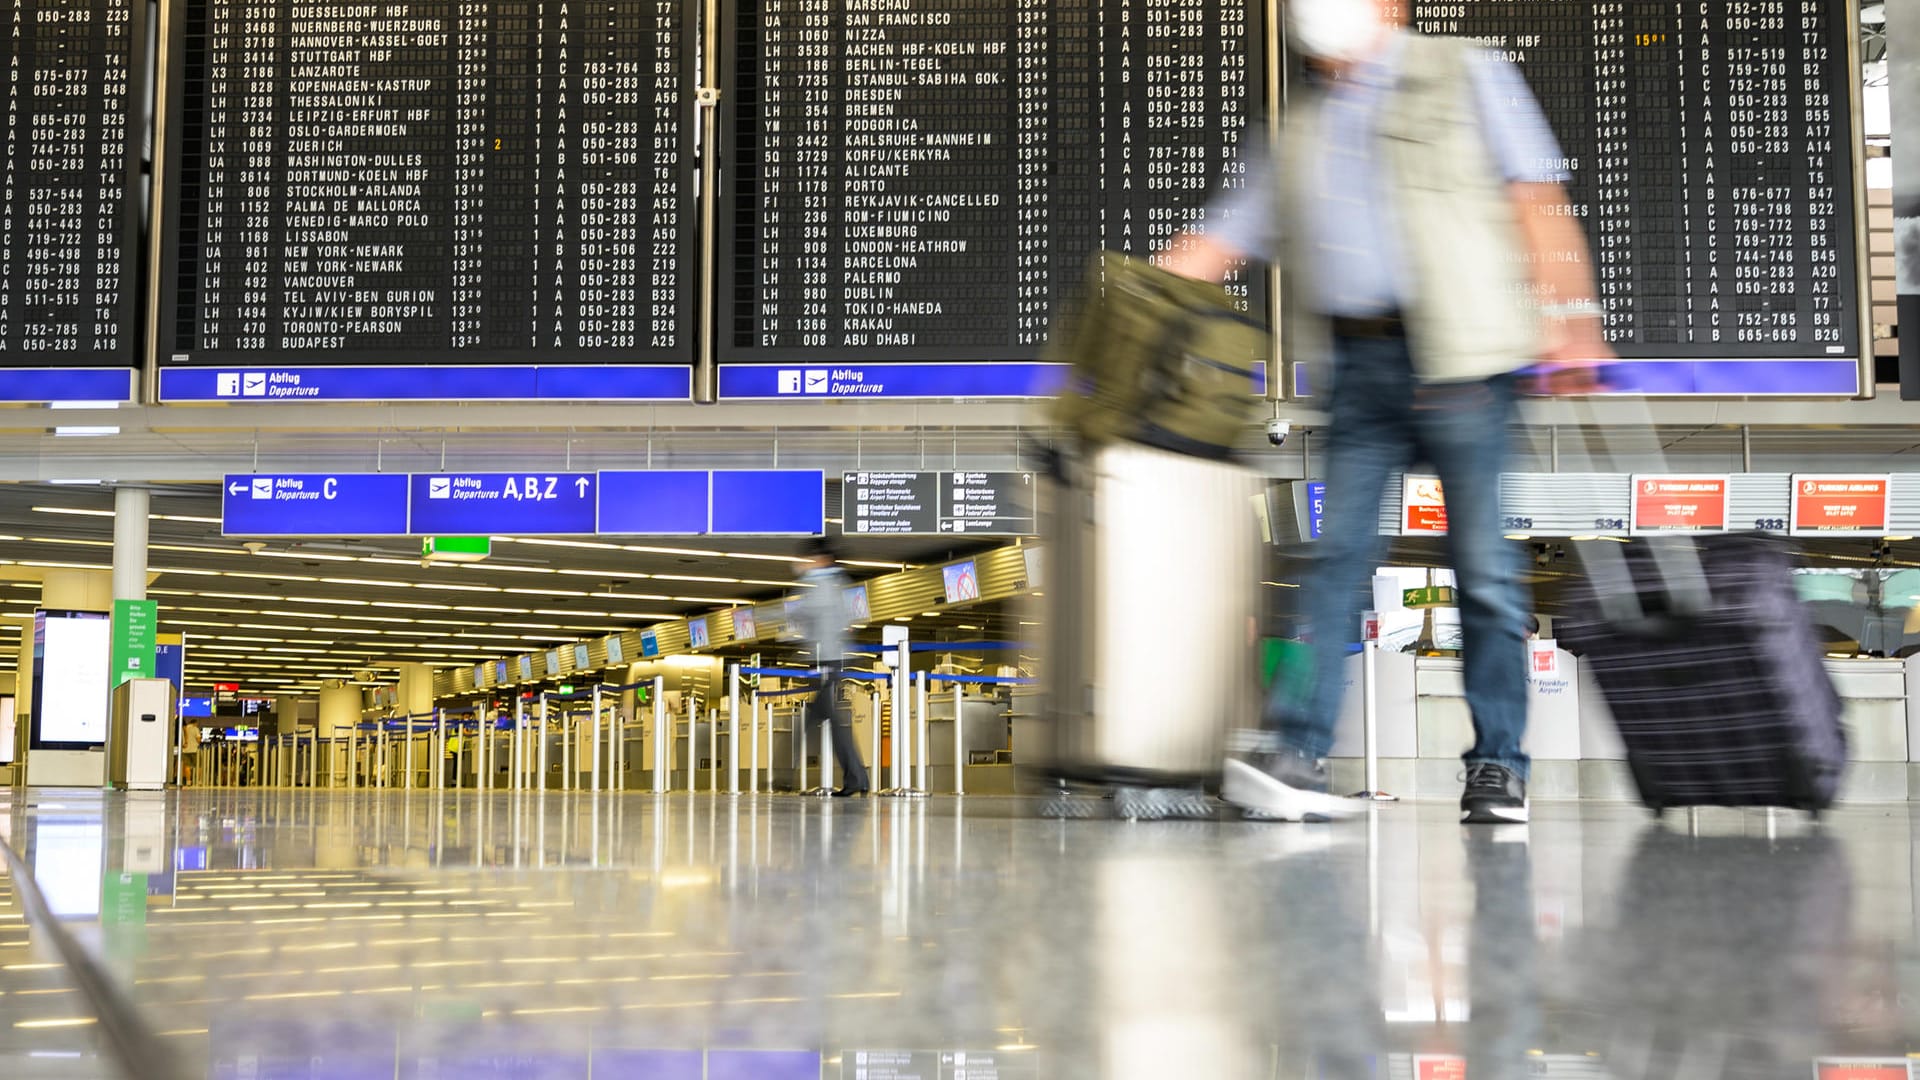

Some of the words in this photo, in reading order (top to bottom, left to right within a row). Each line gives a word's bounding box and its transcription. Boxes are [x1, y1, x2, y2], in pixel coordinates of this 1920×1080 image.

[292, 6, 377, 18] DUESSELDORF
[386, 5, 408, 17] HBF
[846, 0, 909, 11] WARSCHAU
[1416, 5, 1465, 18] RHODOS
[1726, 2, 1783, 14] 752-785
[1801, 2, 1817, 13] B4
[846, 14, 869, 26] SAN
[879, 12, 950, 25] FRANCISCO
[292, 19, 440, 33] NUERNBERG-WUERZBURG
[1417, 21, 1457, 32] TURIN
[291, 34, 448, 48] HANNOVER-KASSEL-GOET
[846, 29, 885, 41] NIZZA
[1517, 35, 1540, 47] HBF
[845, 44, 893, 56] AACHEN
[902, 42, 975, 55] HBF-KOELN
[983, 42, 1006, 54] HBF
[1728, 48, 1785, 60] 517-519
[1803, 48, 1827, 60] B12
[244, 52, 274, 63] 3414
[291, 50, 360, 63] STUTTGART
[370, 50, 392, 61] HBF
[846, 58, 941, 71] BERLIN-TEGEL
[34, 69, 87, 81] 675-677
[104, 69, 126, 80] A24
[291, 65, 359, 77] LANZAROTE
[290, 79, 431, 92] KOPENHAGEN-KASTRUP
[765, 75, 780, 87] TK
[798, 74, 828, 87] 7735
[848, 73, 966, 86] ISTANBUL-SABIHA
[975, 72, 1005, 84] GOK.
[290, 95, 381, 107] THESSALONIKI
[846, 89, 901, 101] DRESDEN
[242, 111, 272, 123] 3734
[290, 110, 399, 122] LEIPZIG-ERFURT
[408, 109, 430, 121] HBF
[846, 104, 893, 116] BREMEN
[289, 124, 406, 137] OSLO-GARDERMOEN
[846, 119, 918, 131] PODGORICA
[845, 133, 991, 146] KARLSRUHE-MANNHEIM
[32, 144, 83, 155] 744-751
[101, 143, 123, 155] B26
[288, 140, 342, 152] ZUERICH
[288, 154, 421, 167] WASHINGTON-DULLES
[583, 152, 637, 164] 501-506
[654, 152, 677, 164] Z20
[846, 149, 950, 161] KORFU/KERKYRA
[287, 170, 397, 182] DORTMUND-KOELN
[406, 169, 428, 181] HBF
[845, 164, 909, 177] ALICANTE
[287, 185, 421, 197] STOCKHOLM-ARLANDA
[764, 181, 779, 193] LH
[798, 180, 827, 192] 1178
[845, 180, 885, 192] PORTO
[30, 189, 82, 200] 537-544
[100, 188, 122, 199] B45
[241, 201, 269, 213] 1152
[286, 201, 325, 212] PALMA
[334, 200, 348, 212] DE
[358, 200, 420, 211] MALLORCA
[764, 196, 777, 208] FI
[805, 196, 826, 208] 521
[845, 194, 999, 207] REYKJAVIK-CANCELLED
[286, 215, 388, 227] VENEDIG-MARCO
[397, 215, 428, 226] POLO
[845, 210, 950, 222] ROM-FIUMICINO
[28, 218, 81, 230] 441-443
[99, 218, 112, 229] C1
[1735, 219, 1792, 231] 769-772
[1810, 218, 1826, 230] B3
[286, 231, 348, 242] LISSABON
[845, 225, 917, 238] LUXEMBURG
[28, 233, 81, 245] 719-722
[98, 233, 112, 244] B9
[1735, 234, 1792, 247] 769-772
[1811, 234, 1826, 246] B5
[285, 246, 308, 257] NEW
[317, 245, 403, 257] YORK-NEWARK
[845, 240, 967, 253] LONDON-HEATHROW
[245, 261, 267, 273] 402
[284, 261, 308, 272] NEW
[317, 260, 402, 272] YORK-NEWARK
[763, 257, 778, 269] LH
[797, 257, 826, 269] 1134
[844, 256, 917, 268] BARCELONA
[27, 263, 80, 275] 795-798
[97, 263, 119, 274] B28
[1736, 266, 1794, 278] 050-283
[1812, 265, 1836, 277] A20
[284, 276, 354, 288] VANCOUVER
[844, 271, 900, 284] PALERMO
[26, 294, 78, 305] 511-515
[96, 293, 118, 304] B47
[205, 292, 219, 303] LH
[244, 292, 266, 303] 694
[284, 291, 305, 303] TEL
[315, 291, 378, 302] AVIV-BEN
[387, 290, 434, 302] GURION
[844, 287, 893, 299] DUBLIN
[205, 307, 219, 319] LH
[238, 307, 266, 318] 1494
[283, 306, 362, 318] KYJIW/KIEW
[371, 306, 433, 318] BORYSPIL
[762, 303, 778, 315] NH
[804, 303, 826, 315] 204
[845, 302, 942, 315] TOKIO-HANEDA
[844, 318, 892, 330] KRAKAU
[1738, 313, 1796, 325] 752-785
[1814, 313, 1830, 325] B9
[204, 323, 218, 334] LH
[243, 322, 265, 333] 470
[283, 321, 401, 333] TORONTO-PEARSON
[204, 338, 218, 349] LH
[236, 337, 265, 349] 1338
[282, 337, 345, 348] BUDAPEST
[762, 334, 777, 346] EY
[803, 334, 826, 346] 008
[844, 334, 867, 345] ABU
[877, 333, 915, 345] DHABI
[269, 372, 300, 385] Abflug
[832, 370, 863, 383] Abflug
[269, 386, 319, 397] Departures
[832, 383, 883, 395] Departures
[276, 478, 303, 489] Abflug
[324, 477, 337, 500] C
[453, 477, 482, 488] Abflug
[1818, 484, 1847, 492] TURKISH
[1848, 484, 1879, 492] AIRLINES
[276, 489, 319, 500] Departures
[453, 489, 499, 500] Departures
[503, 477, 557, 502] A,B,Z
[1505, 517, 1532, 529] 535
[1595, 518, 1623, 529] 534
[1754, 518, 1784, 530] 533
[1539, 679, 1568, 687] Frankfurt
[1539, 687, 1562, 695] Airport
